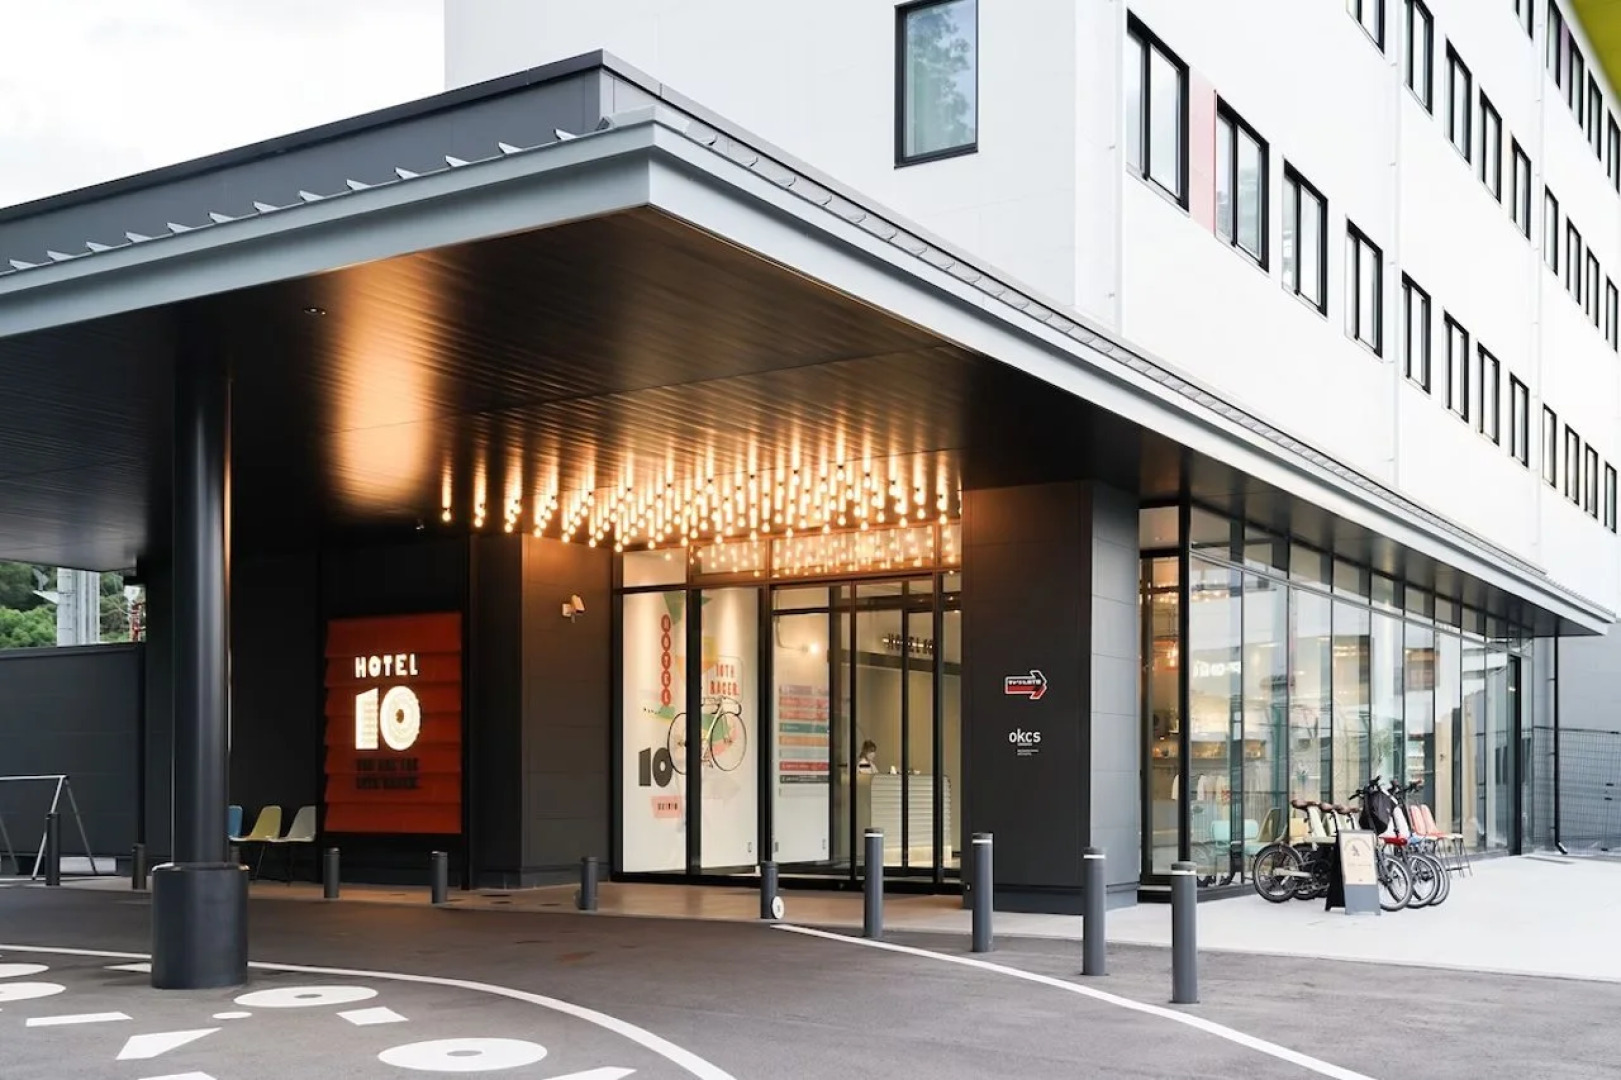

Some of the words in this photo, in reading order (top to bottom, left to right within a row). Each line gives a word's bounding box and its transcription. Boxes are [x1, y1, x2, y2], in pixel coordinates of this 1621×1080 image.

[355, 653, 419, 678] HOTEL
[661, 614, 671, 704] HOTEL
[355, 685, 421, 751] 10
[1008, 728, 1041, 743] okcs
[638, 747, 672, 787] 10
